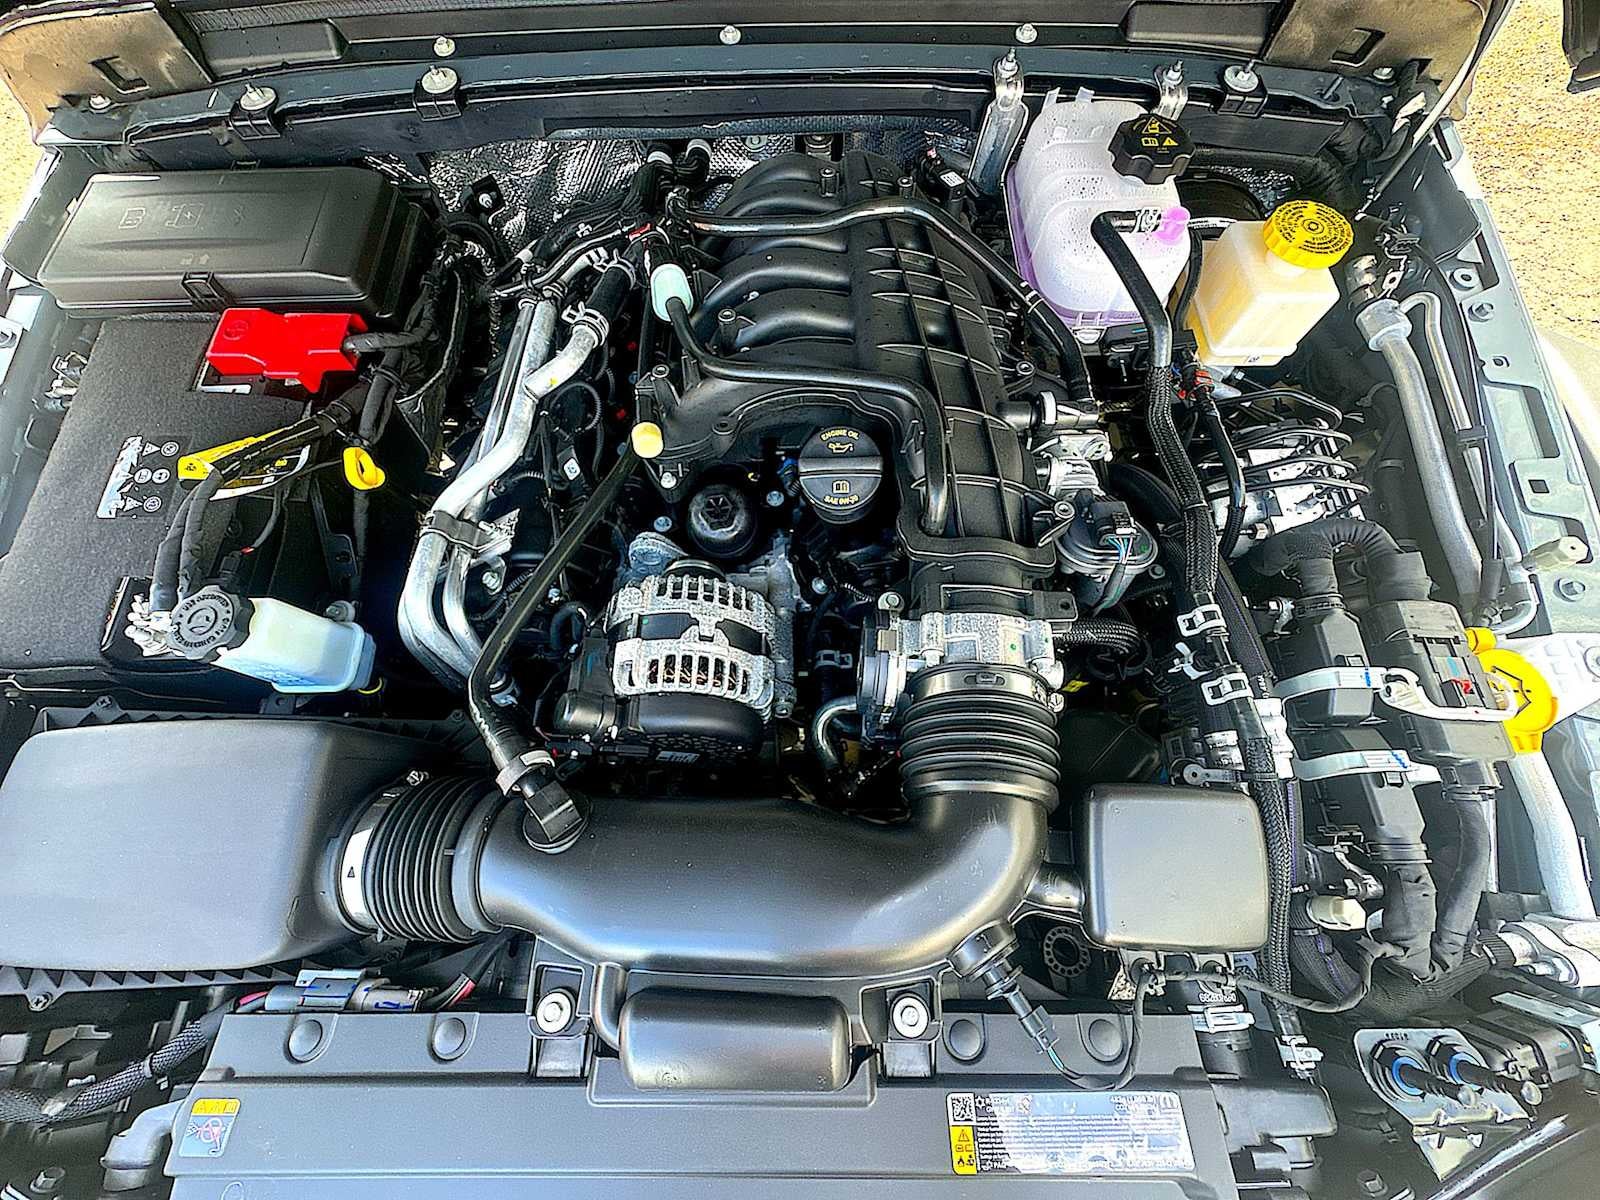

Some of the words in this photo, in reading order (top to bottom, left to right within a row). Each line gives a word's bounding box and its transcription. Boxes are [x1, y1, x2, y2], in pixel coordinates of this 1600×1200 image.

[821, 429, 848, 441] ENGINE
[848, 430, 859, 440] OIL
[824, 495, 838, 505] SAE
